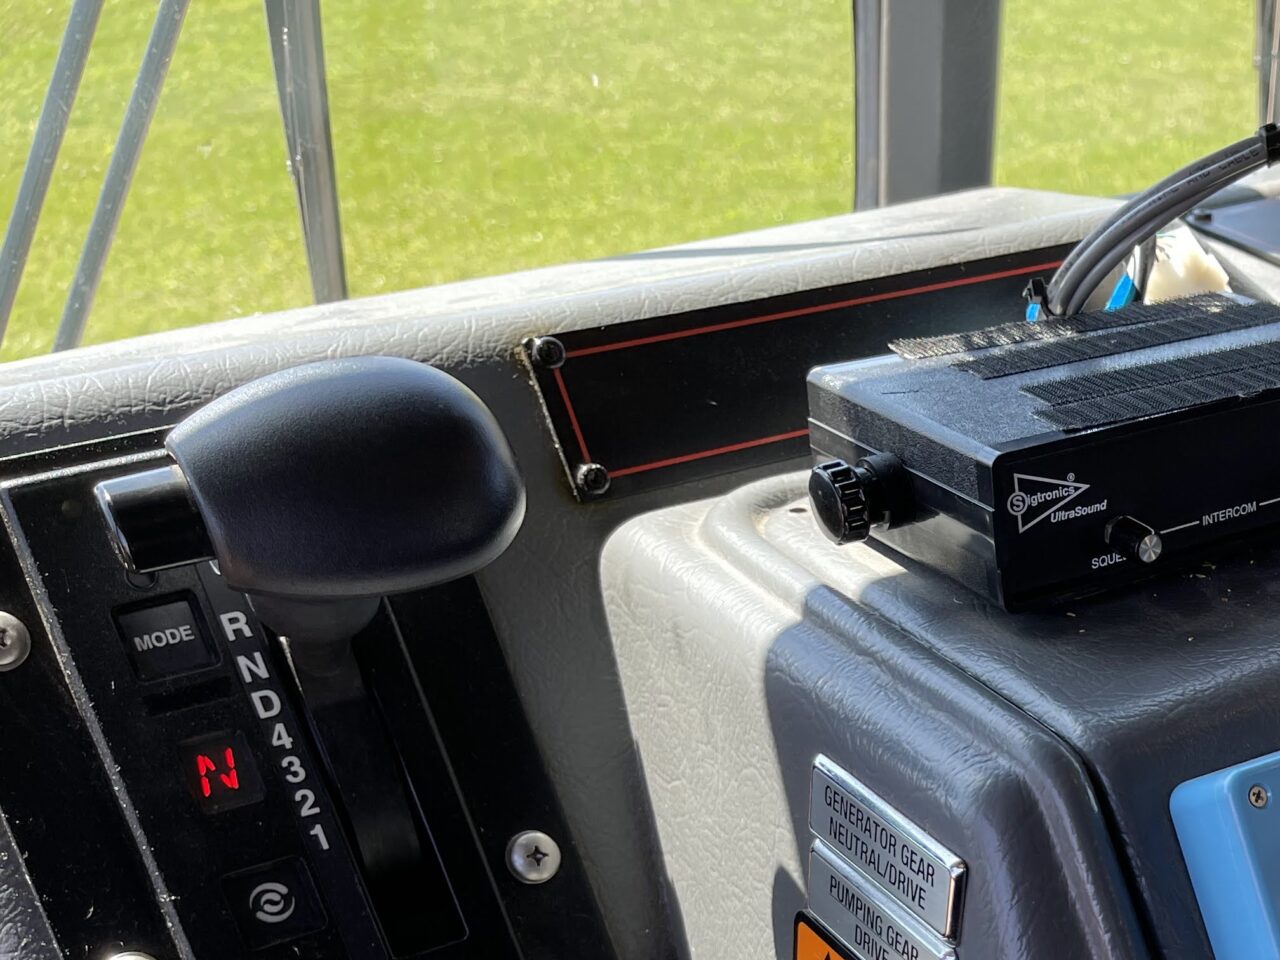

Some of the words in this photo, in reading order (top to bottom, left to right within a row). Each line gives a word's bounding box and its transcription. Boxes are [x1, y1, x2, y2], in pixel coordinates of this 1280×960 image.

[1010, 486, 1076, 513] Sigtronics
[1050, 499, 1108, 523] UltraSound
[1202, 501, 1257, 526] INTERCOM
[134, 624, 196, 652] MODE
[220, 610, 253, 642] R
[237, 651, 270, 683] N
[252, 688, 282, 720] D
[272, 723, 293, 749] 4
[196, 747, 240, 798] N
[281, 755, 306, 783] 3
[295, 789, 320, 818] 2
[310, 823, 330, 851] 1
[824, 785, 896, 857] GENERATOR
[901, 844, 934, 887] GEAR
[829, 816, 926, 909] NEUTRAL/DRIVE
[829, 874, 882, 936] PUMPING
